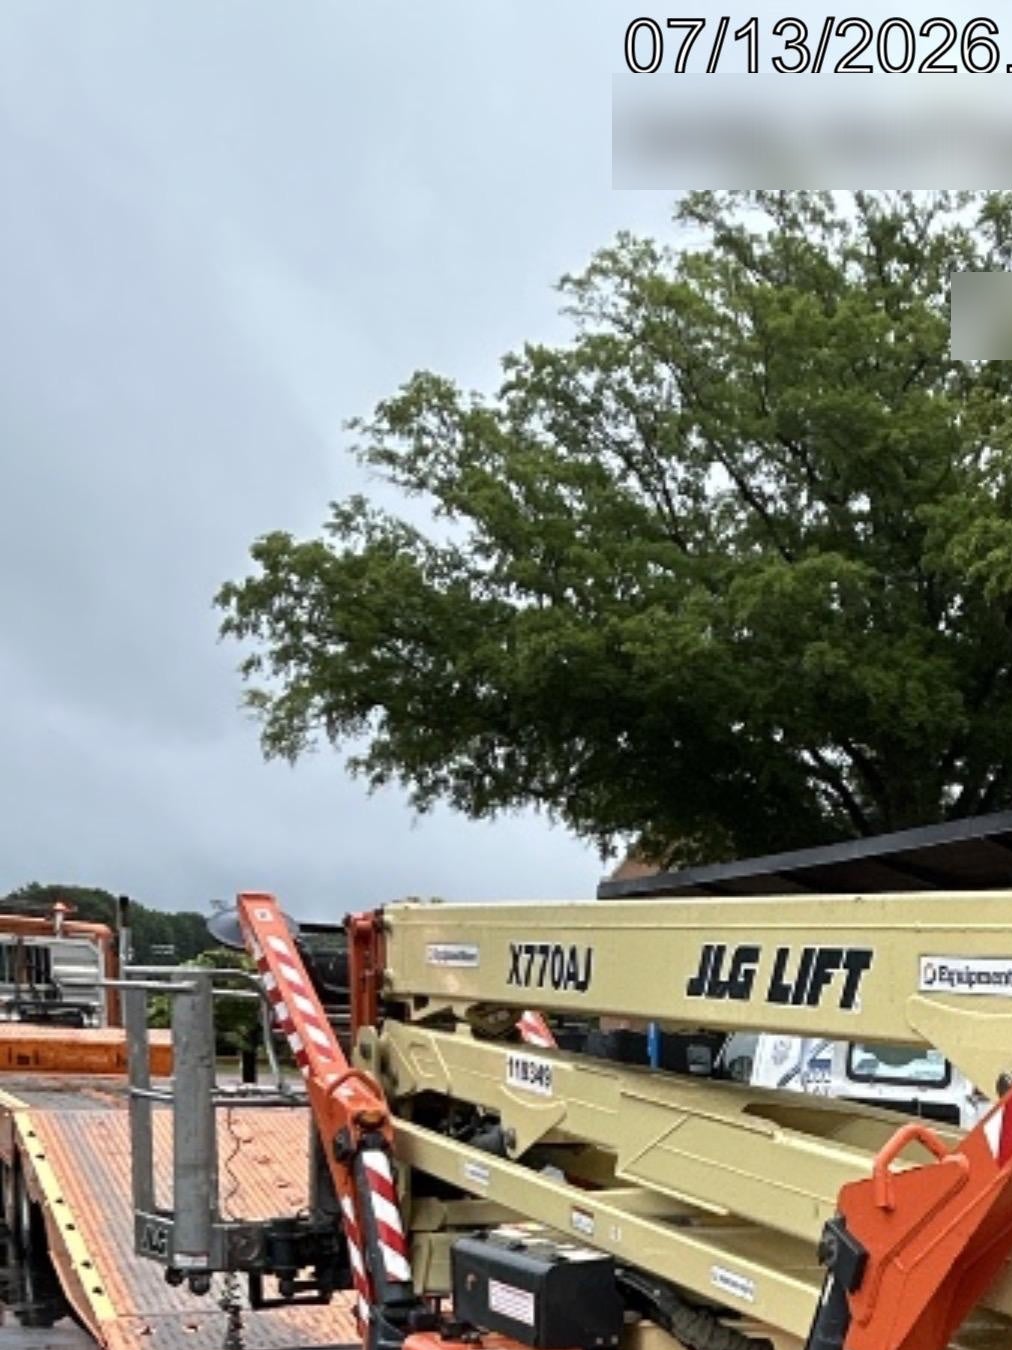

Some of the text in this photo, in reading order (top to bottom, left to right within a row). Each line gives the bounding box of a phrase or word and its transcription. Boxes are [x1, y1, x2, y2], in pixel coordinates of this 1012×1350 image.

[507, 943, 593, 993] X770AJ
[686, 944, 874, 1010] JLG LIFT
